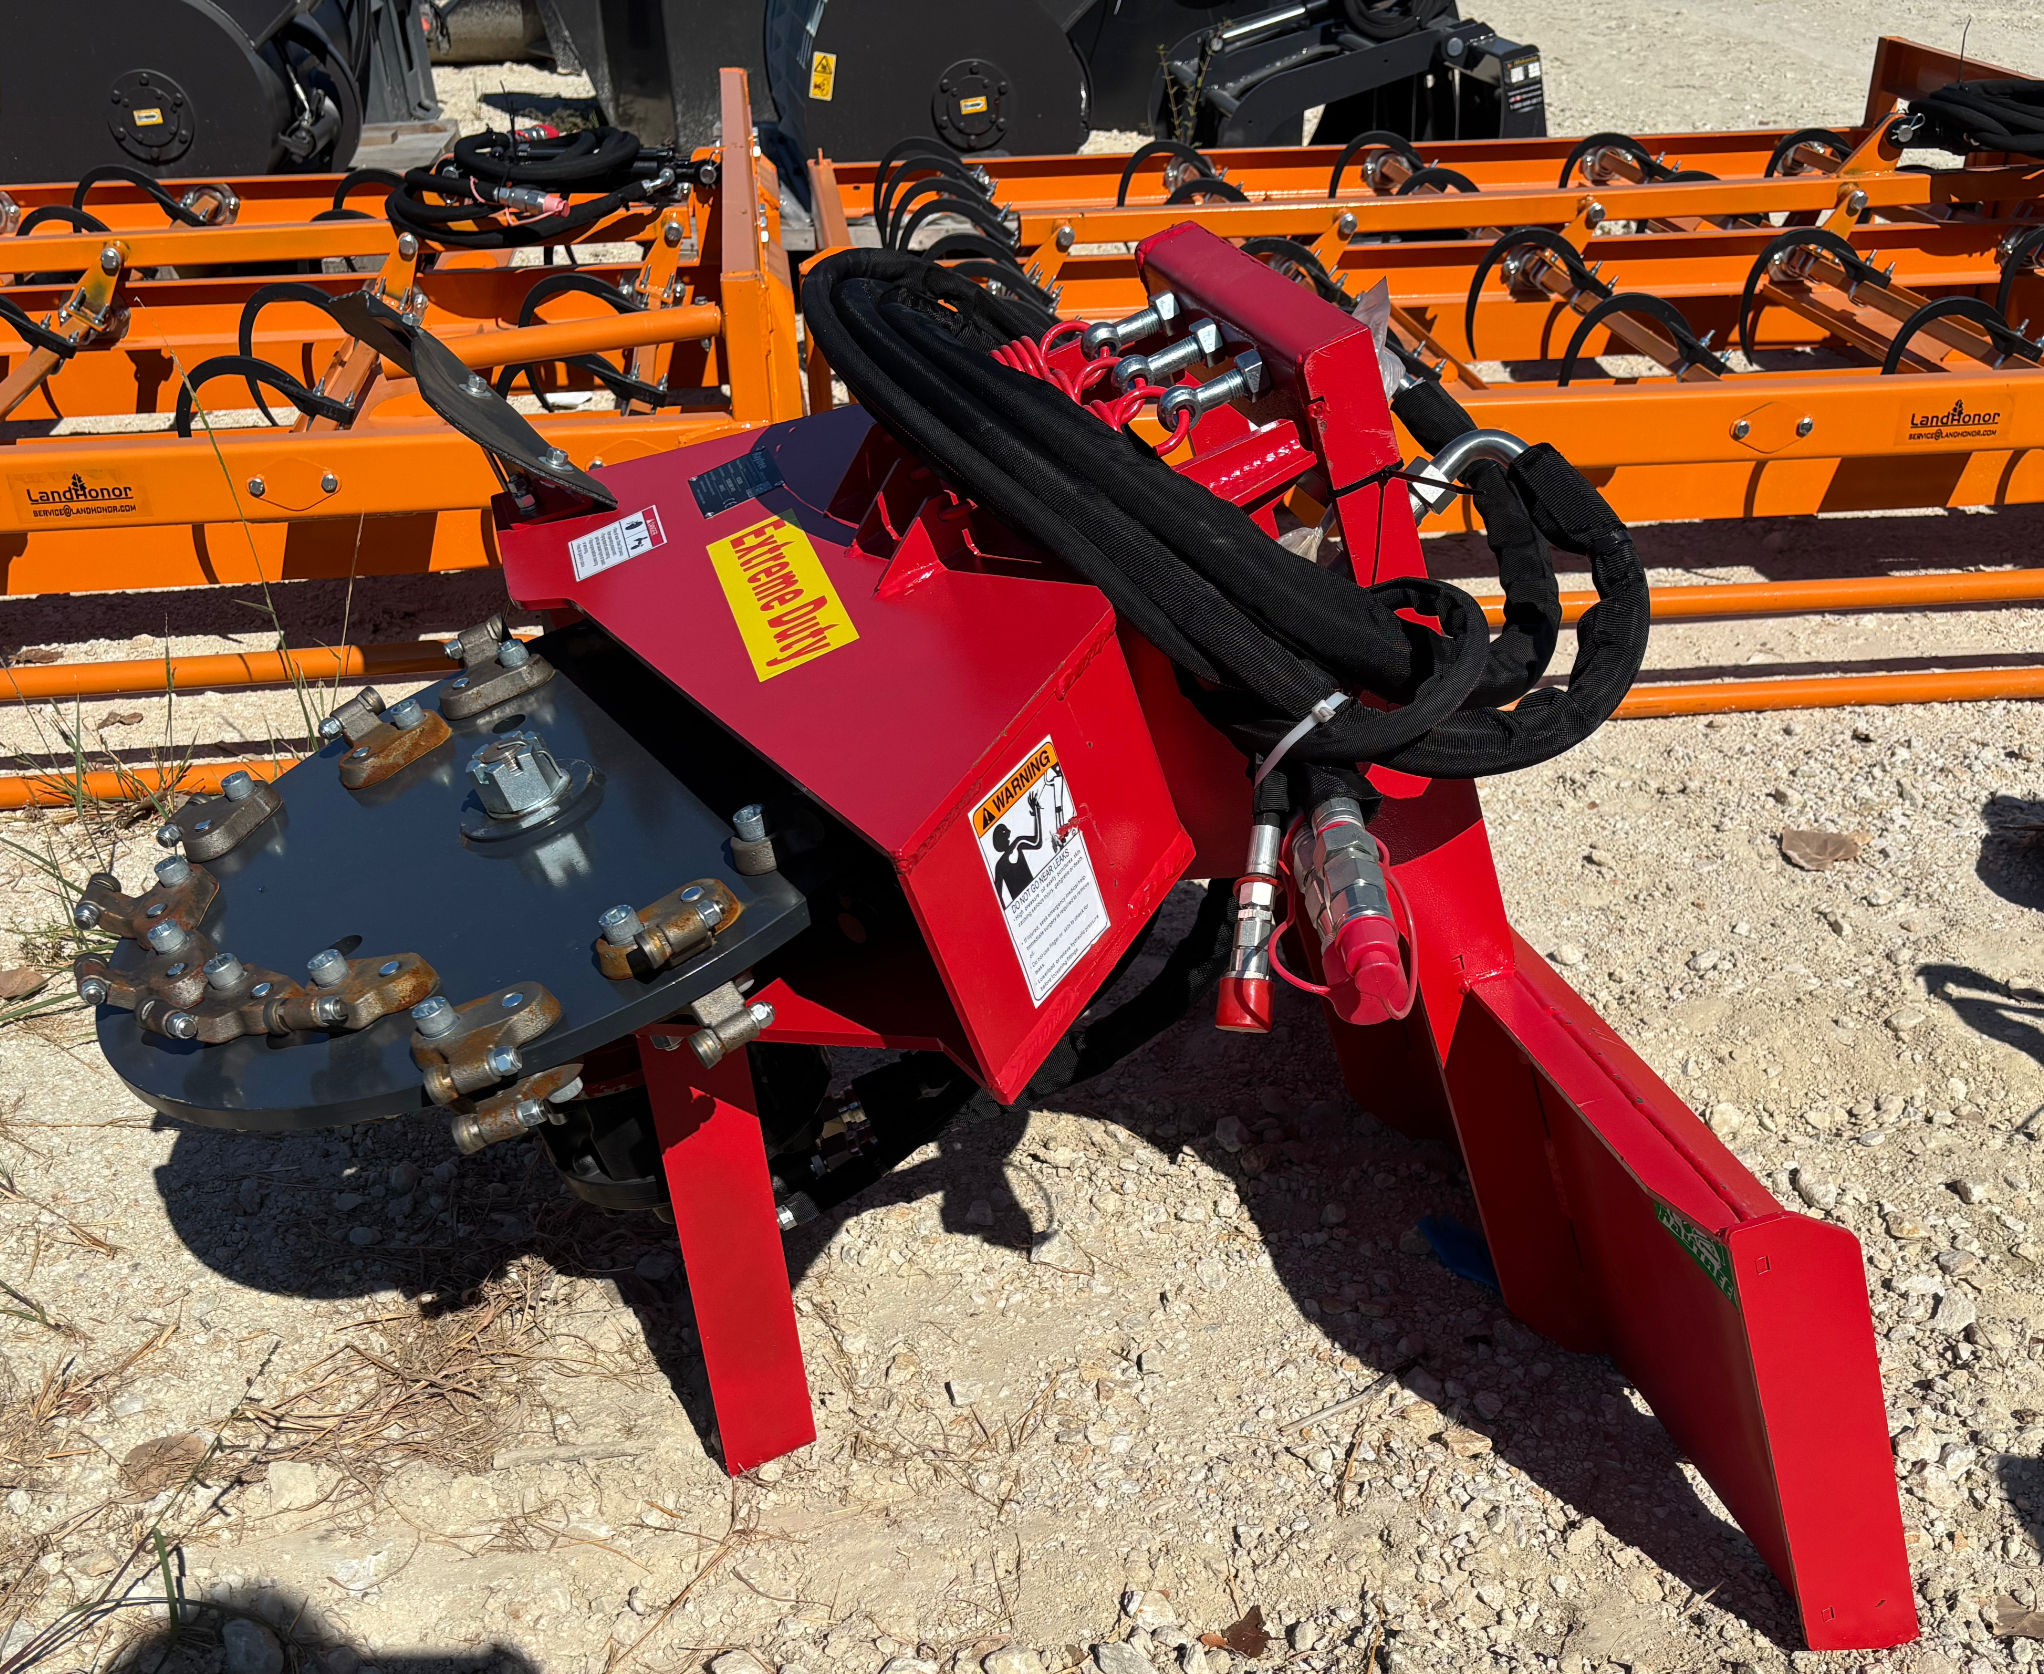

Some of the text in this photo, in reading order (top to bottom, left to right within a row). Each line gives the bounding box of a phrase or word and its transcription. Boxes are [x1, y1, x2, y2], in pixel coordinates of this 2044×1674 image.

[1910, 411, 2000, 426] LandHonor
[1908, 429, 1997, 441] SERVICE@LANDHONOR.COM
[26, 486, 132, 503] LandHonor
[32, 504, 137, 518] SERVICE@LANDHONOR.COM
[730, 519, 840, 668] Extreme Duty
[992, 748, 1050, 815] WARNING
[1011, 848, 1069, 913] DO NOT GO NEAR LEAKS
